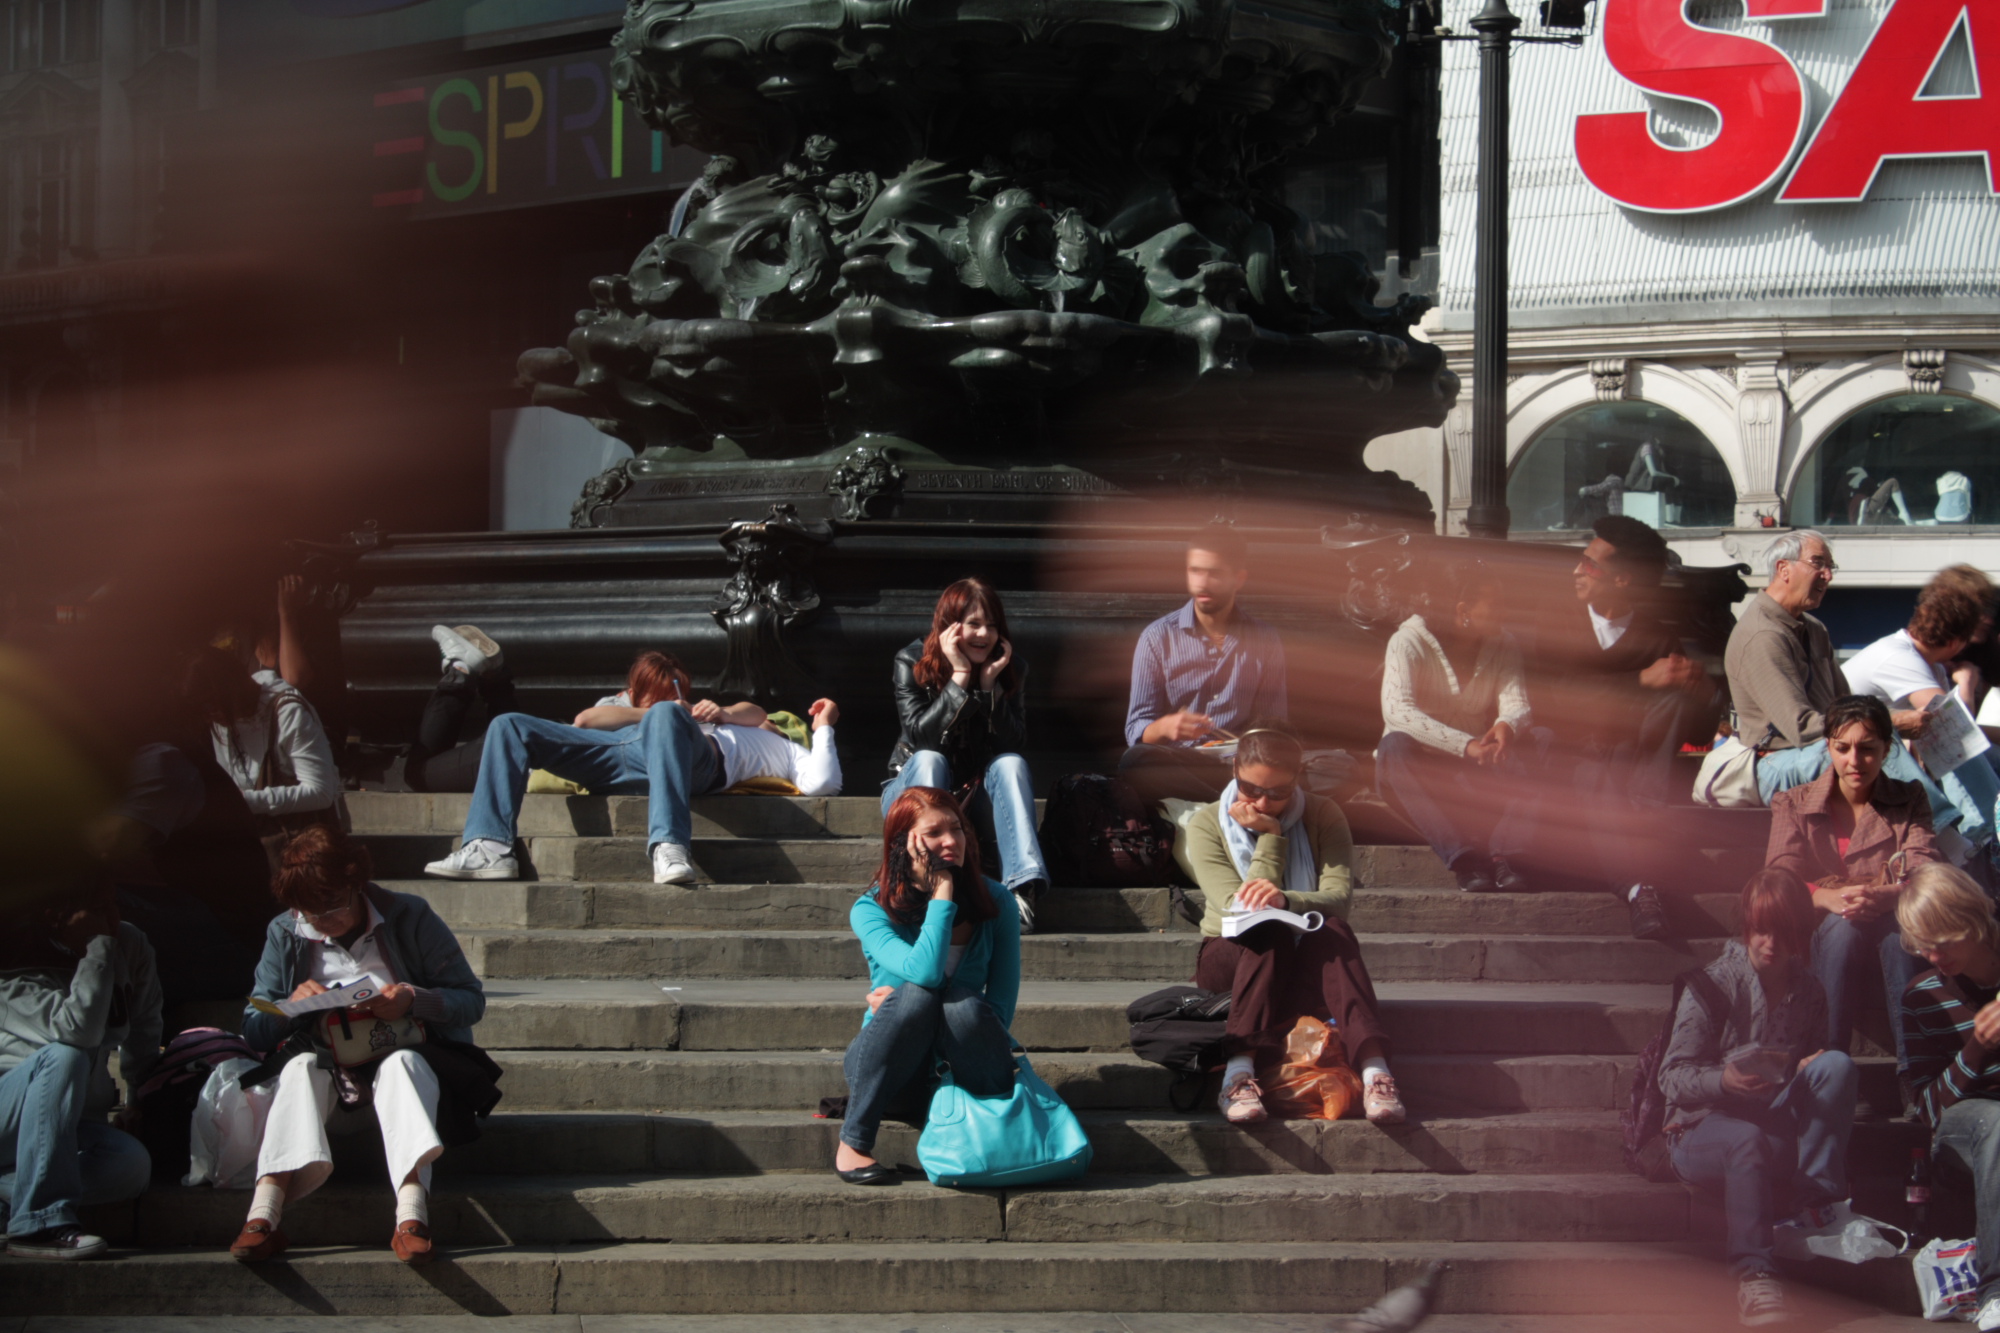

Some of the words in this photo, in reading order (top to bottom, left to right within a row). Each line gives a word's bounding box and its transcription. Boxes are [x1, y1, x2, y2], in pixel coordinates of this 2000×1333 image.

[1573, 0, 2000, 214] SA
[917, 473, 984, 489] SEVENTH
[989, 473, 1030, 489] EARL
[1035, 475, 1054, 489] OF
